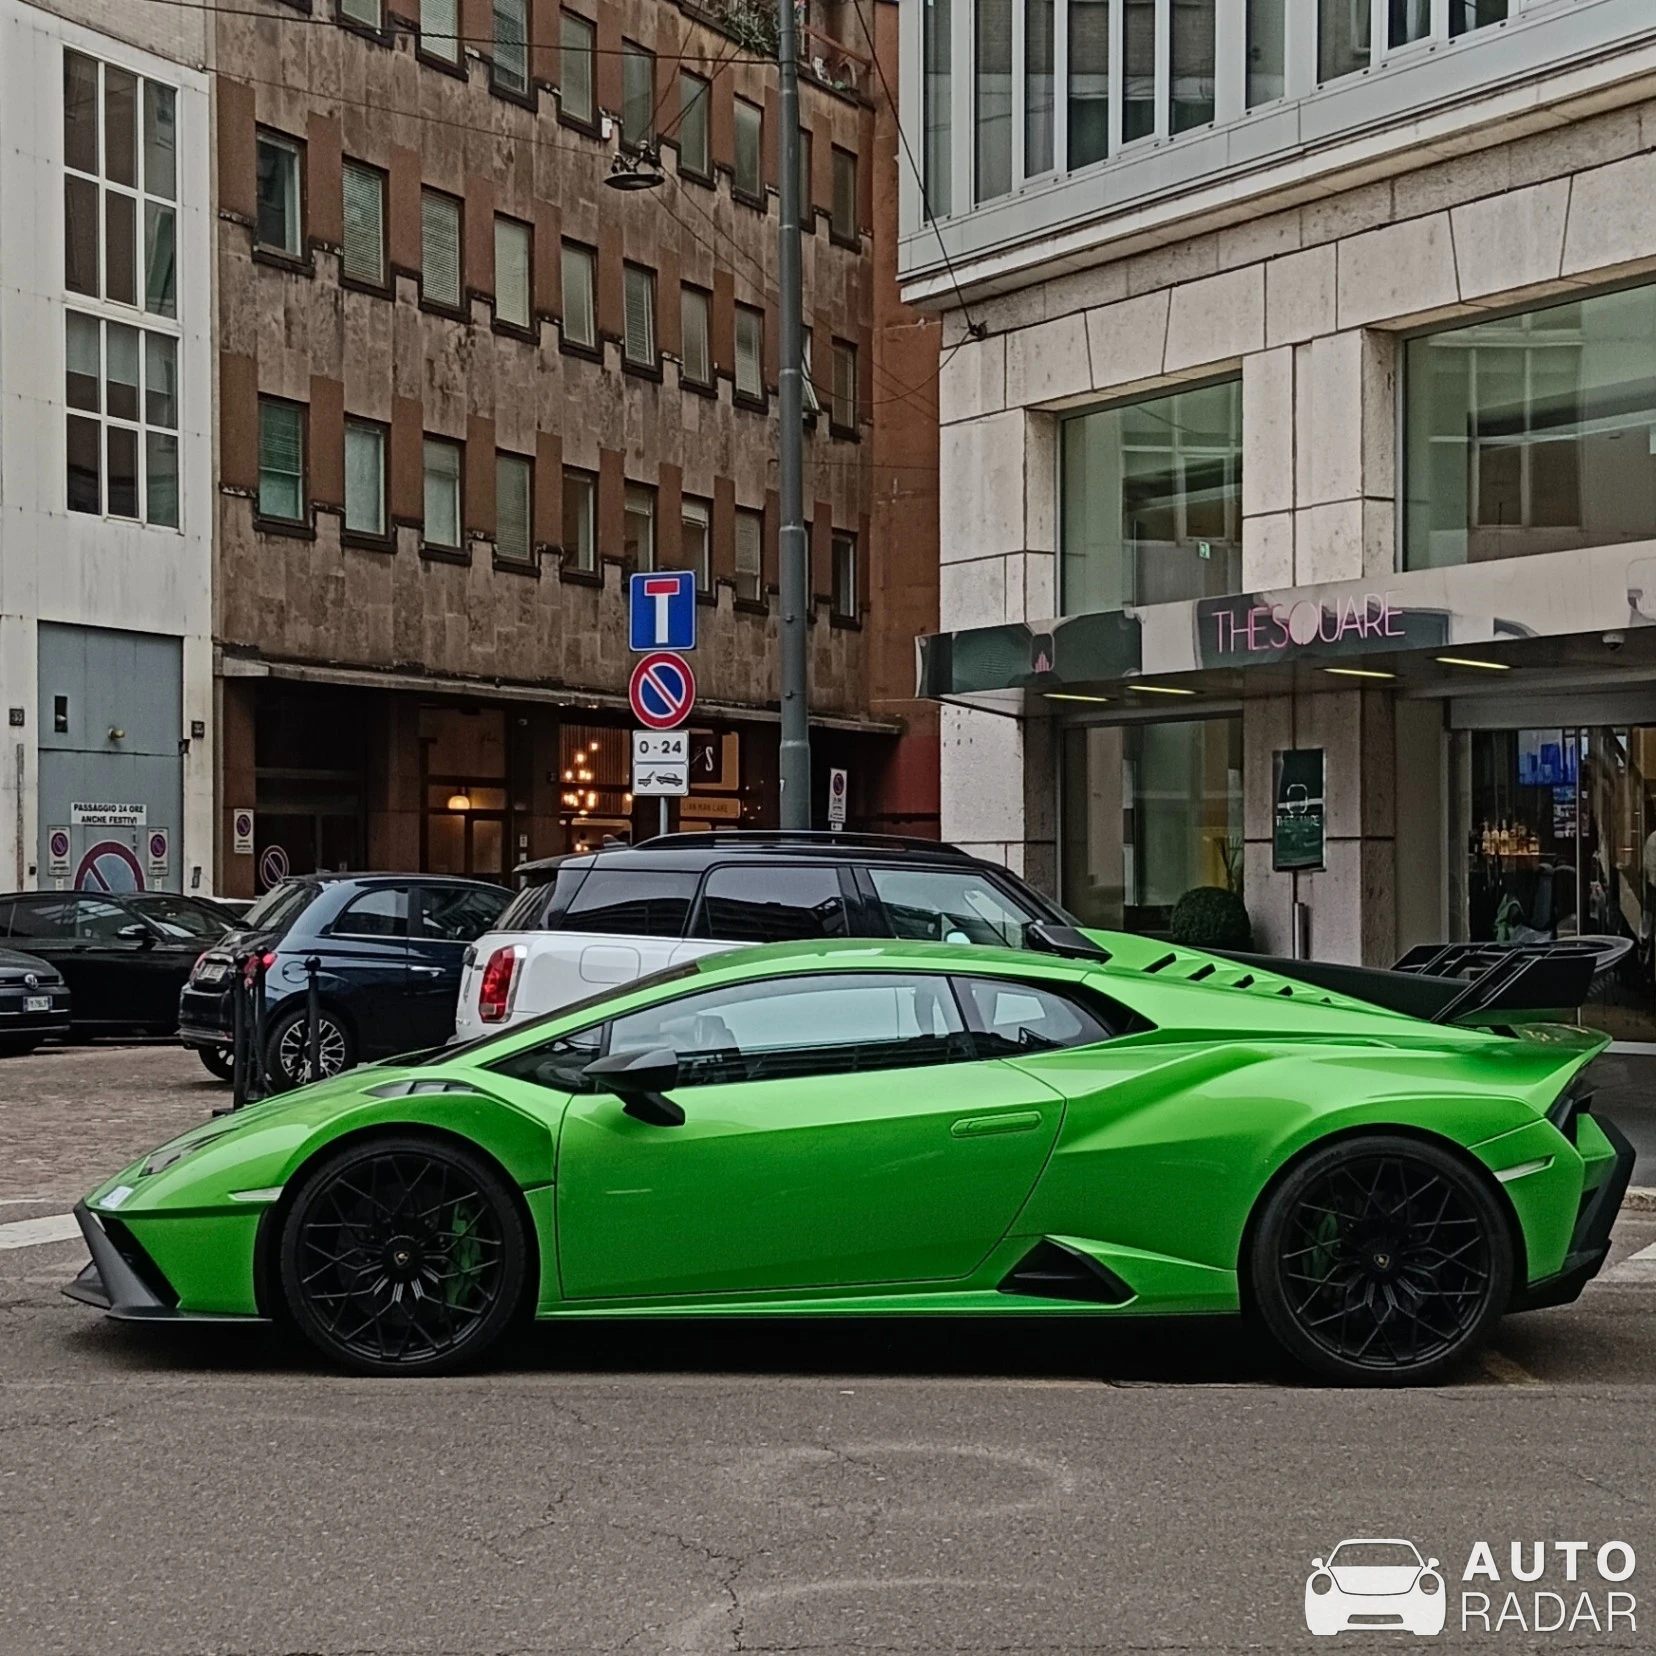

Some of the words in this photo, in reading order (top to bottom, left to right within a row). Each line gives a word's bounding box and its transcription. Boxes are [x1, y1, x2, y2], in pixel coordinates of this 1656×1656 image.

[73, 803, 117, 813] PASSAGGIO
[118, 804, 128, 813] 24
[129, 805, 144, 814] ORE
[81, 815, 107, 824] ANCHE
[108, 816, 137, 825] FESTIVI
